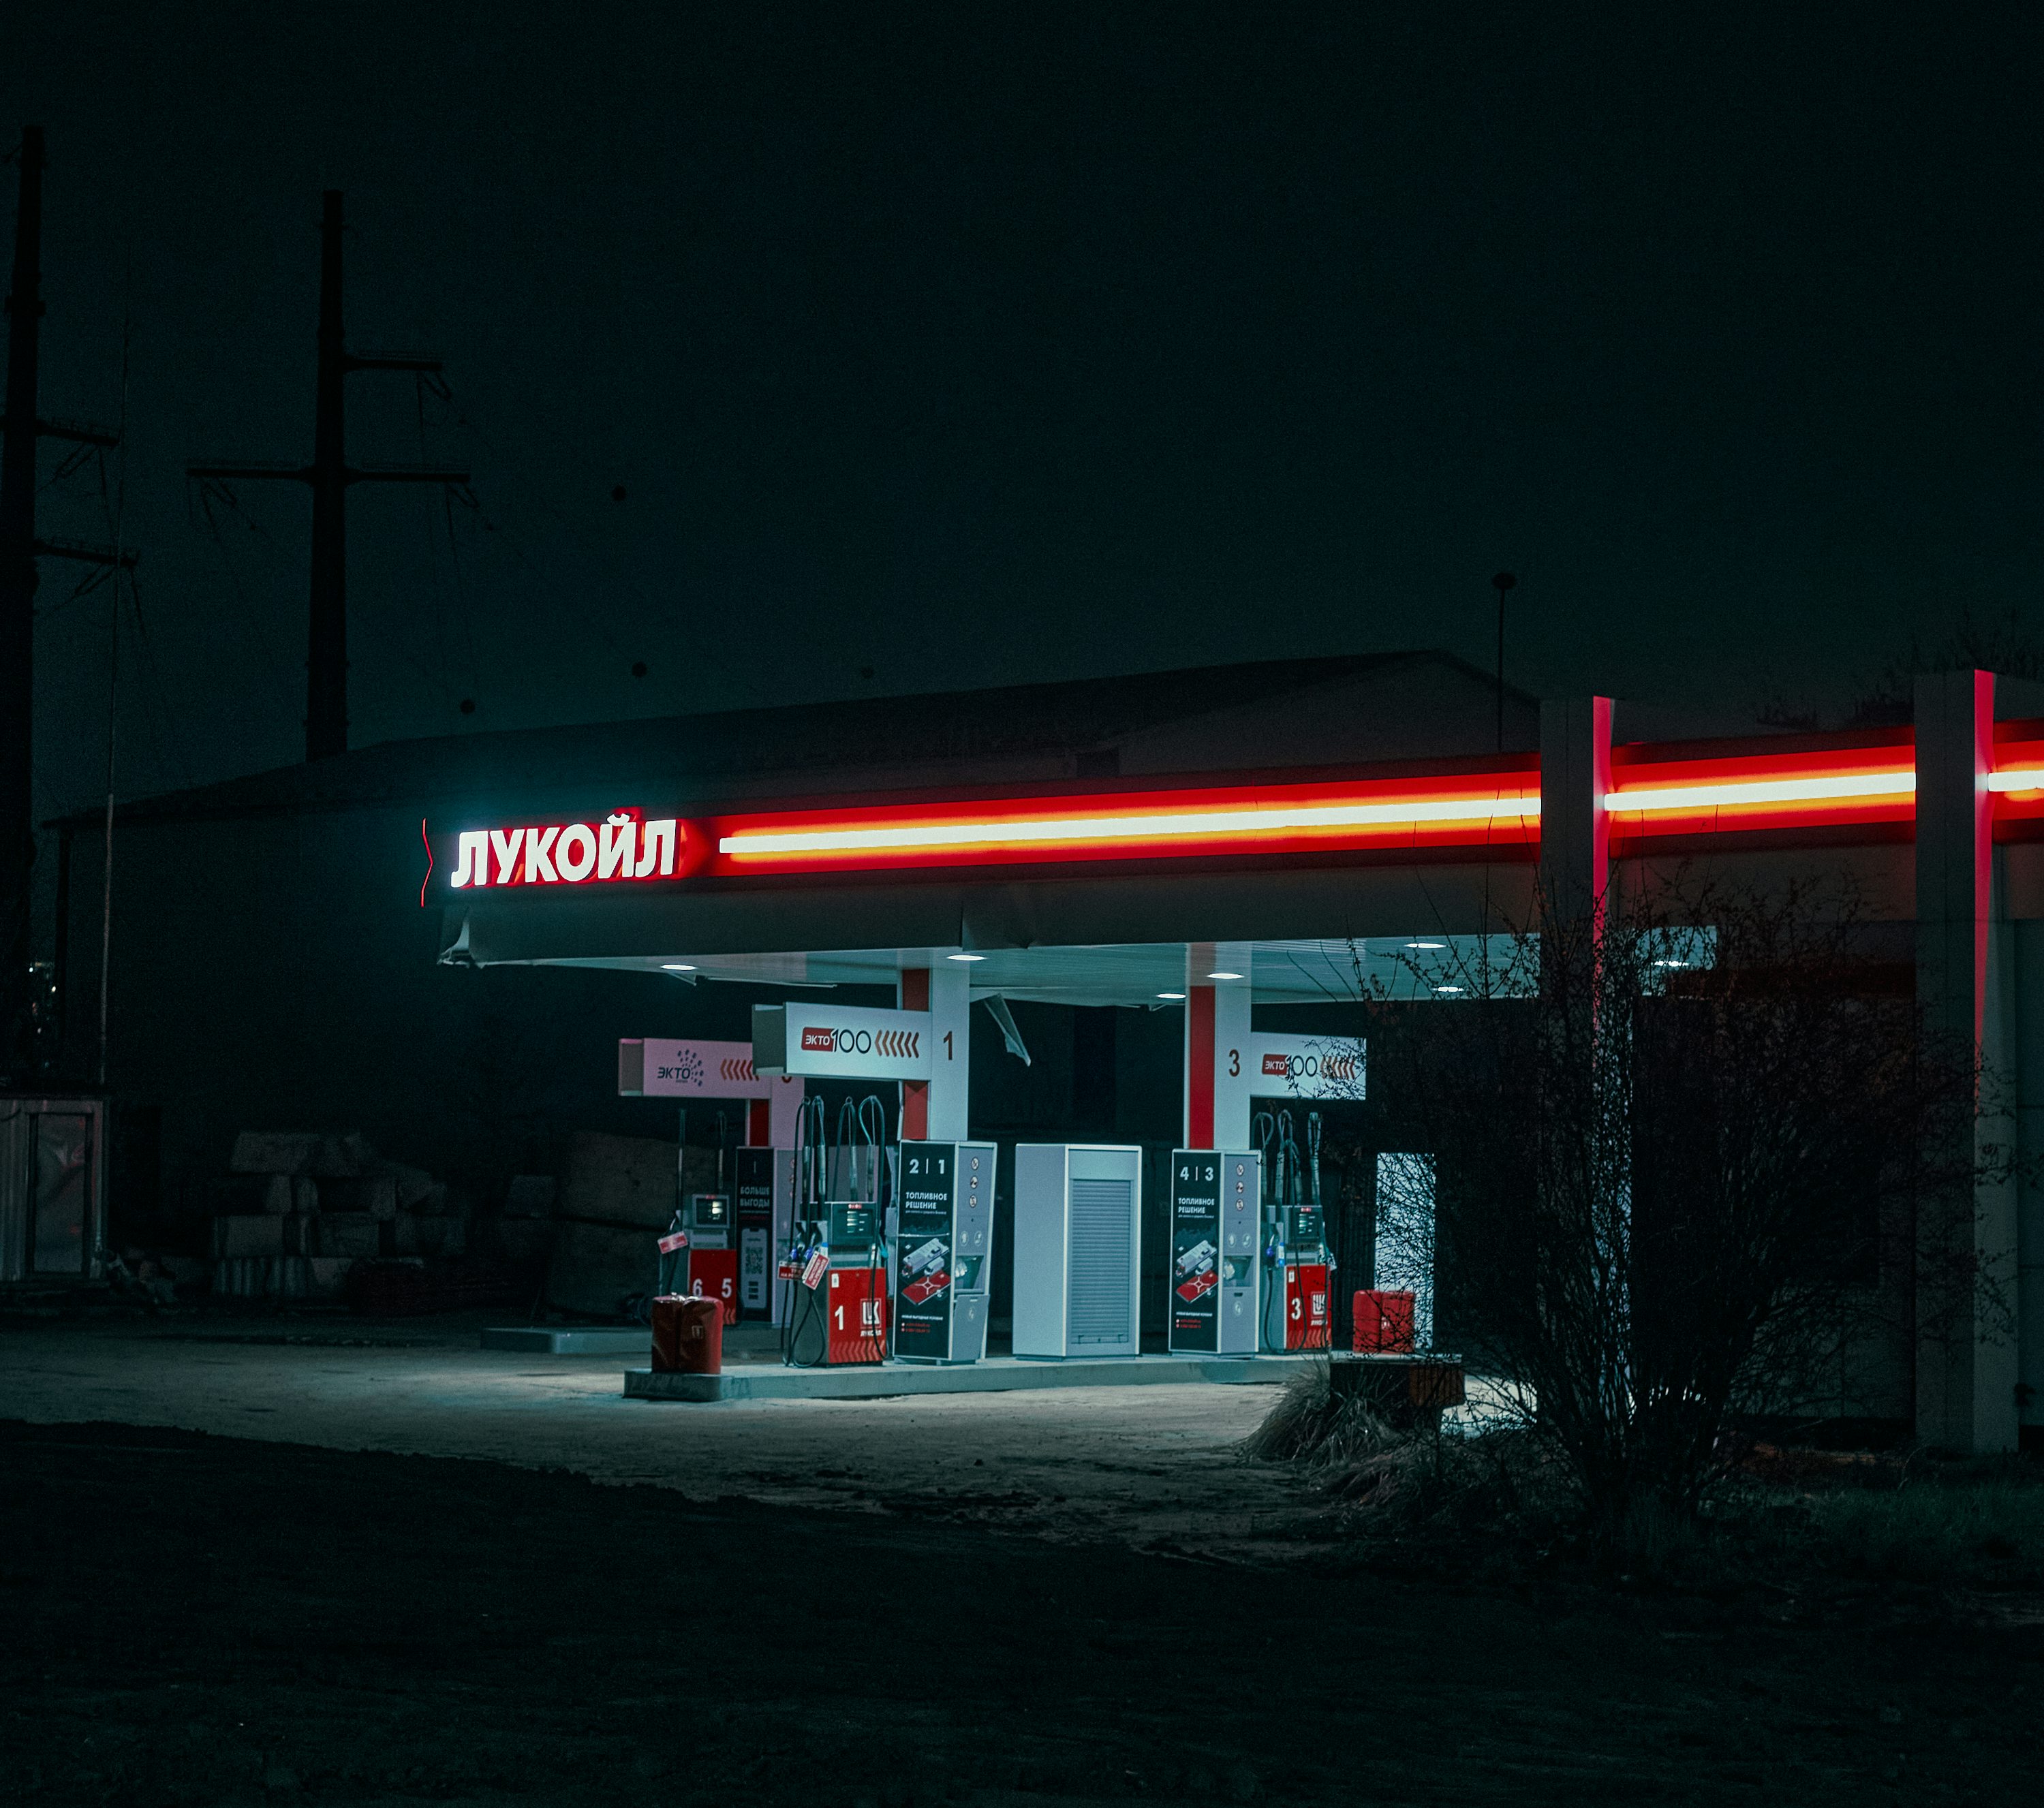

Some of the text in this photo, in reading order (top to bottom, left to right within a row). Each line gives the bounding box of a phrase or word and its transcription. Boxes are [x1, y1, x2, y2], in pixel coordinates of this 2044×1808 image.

[451, 813, 677, 888] ЛУКОЙЛ
[943, 1030, 953, 1061] 1
[1228, 1049, 1240, 1077] 3
[657, 1067, 691, 1080] ЭКТО
[909, 1158, 945, 1174] 2 1
[1179, 1166, 1214, 1181] 4 3
[905, 1191, 948, 1200] ТОПЛИВНОЕ
[1178, 1197, 1215, 1206] ТОПЛИВНОЕ
[739, 1198, 770, 1209] ВЫГОДЫ
[905, 1201, 937, 1209] РЕШЕНИЕ
[1178, 1206, 1205, 1214] РЕШЕНИЕ
[692, 1277, 732, 1298] 6 5
[1291, 1297, 1301, 1320] 3
[835, 1305, 844, 1330] 1
